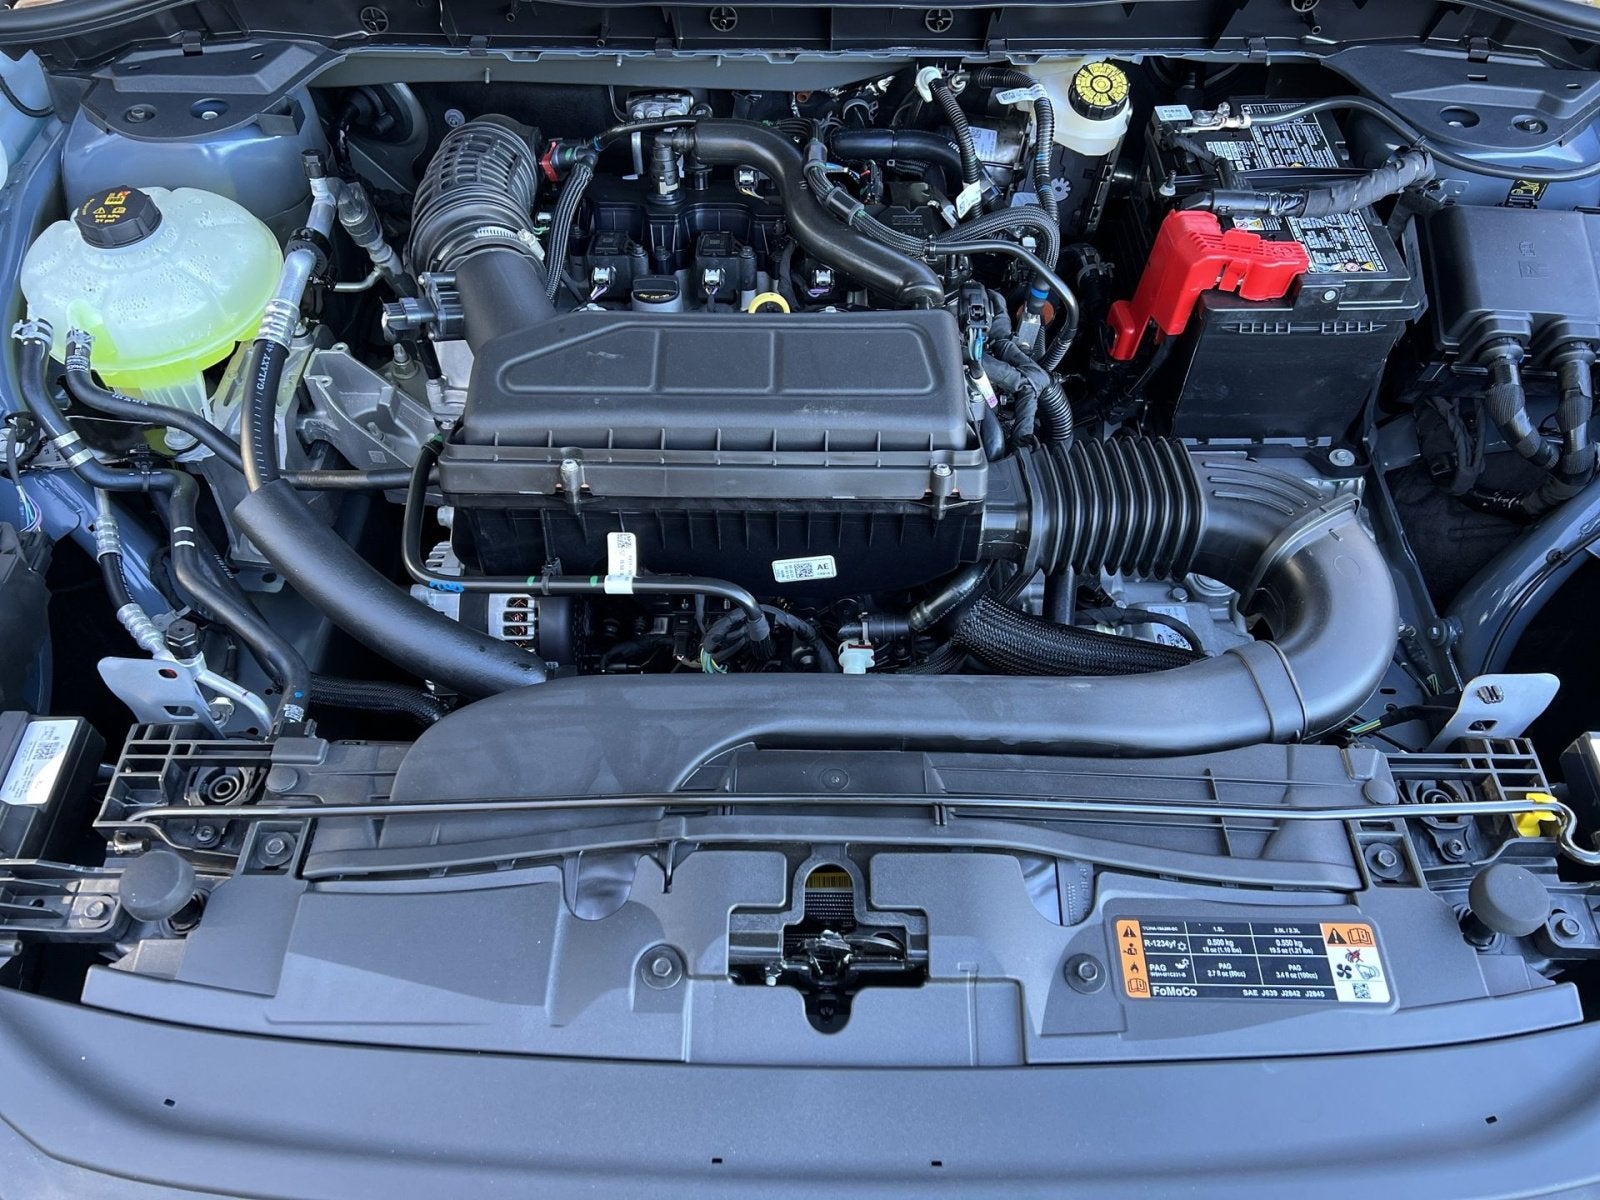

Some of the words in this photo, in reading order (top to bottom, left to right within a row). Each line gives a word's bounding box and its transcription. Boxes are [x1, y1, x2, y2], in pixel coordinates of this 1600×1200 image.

[256, 353, 270, 390] GALAXY
[1144, 940, 1176, 949] R-1234yf
[1225, 939, 1234, 948] kg
[1294, 939, 1303, 948] kg
[1152, 986, 1198, 996] FoMoCo
